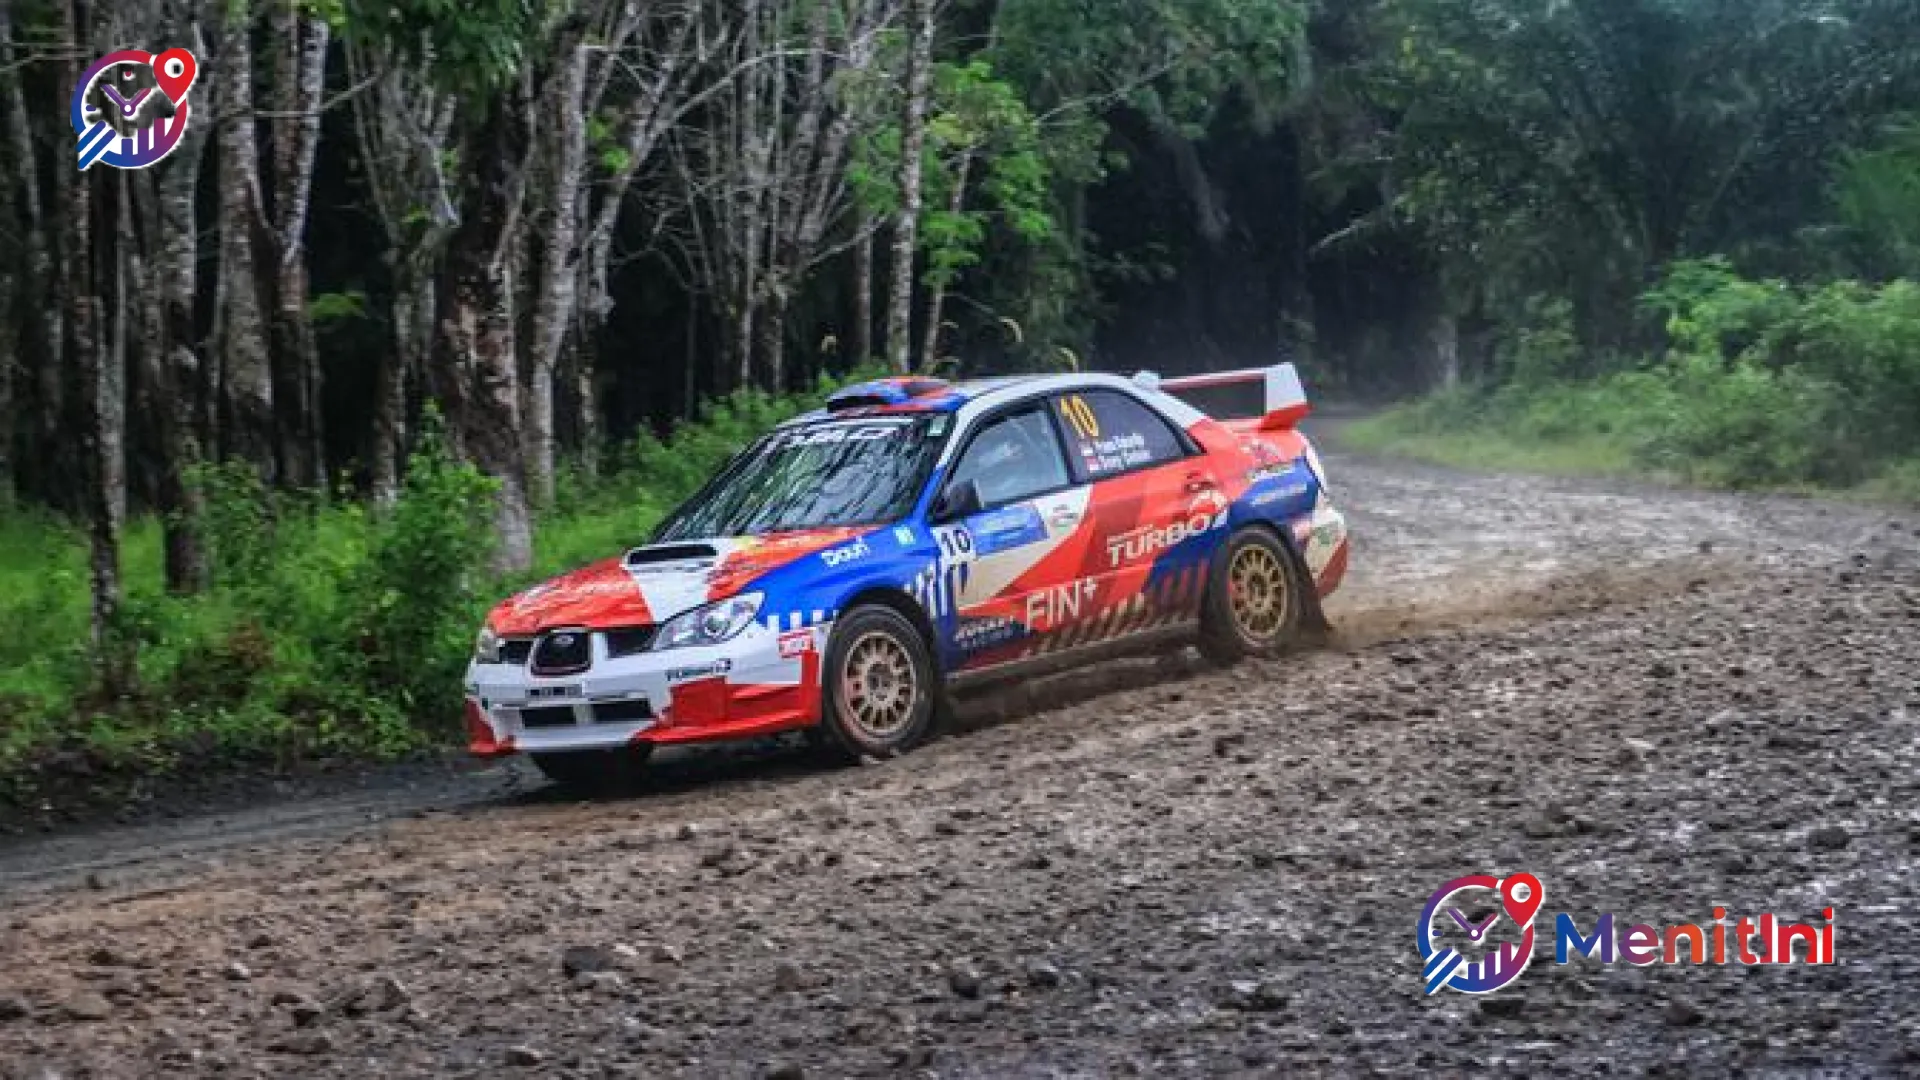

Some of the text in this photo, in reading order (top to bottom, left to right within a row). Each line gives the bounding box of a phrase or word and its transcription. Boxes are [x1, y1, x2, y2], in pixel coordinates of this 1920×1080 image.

[1060, 396, 1099, 439] 10
[940, 528, 971, 556] 10
[1107, 513, 1213, 567] TURBO
